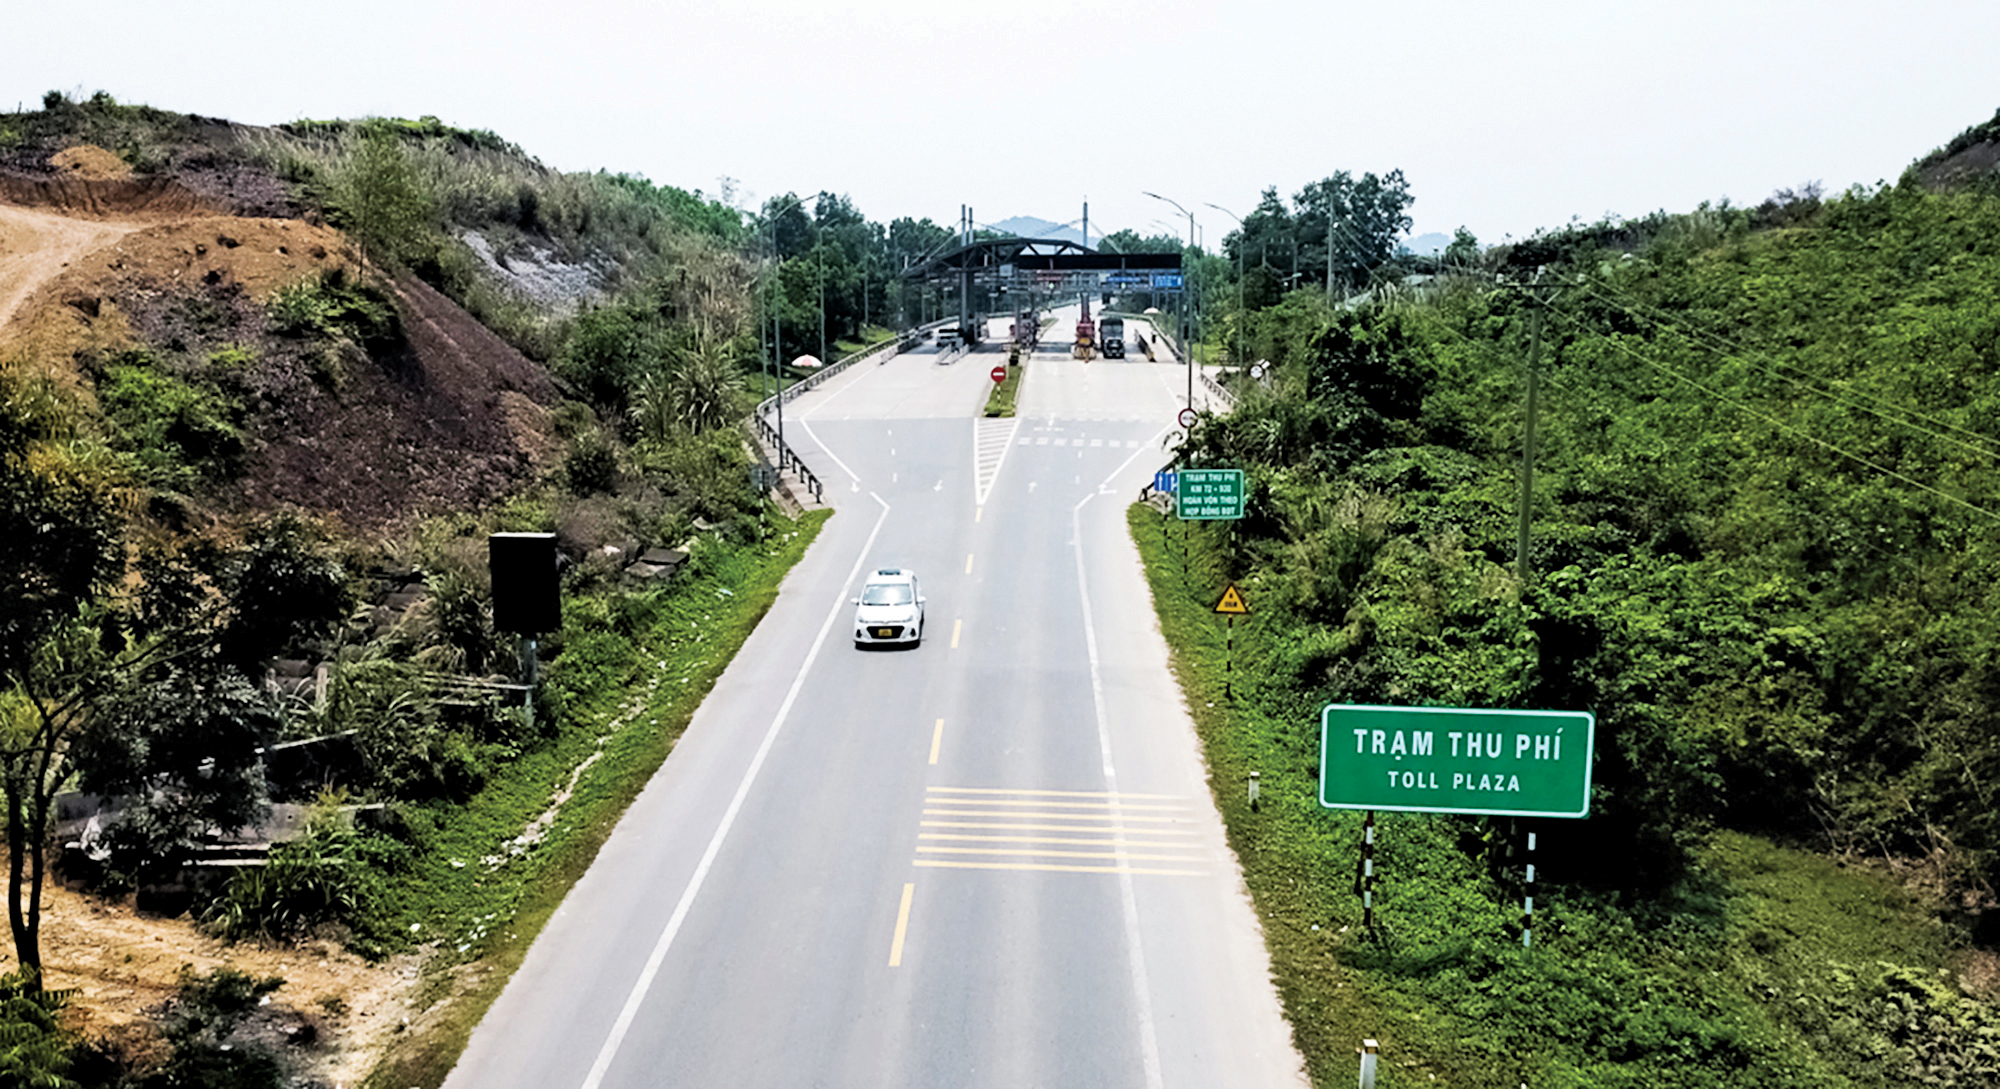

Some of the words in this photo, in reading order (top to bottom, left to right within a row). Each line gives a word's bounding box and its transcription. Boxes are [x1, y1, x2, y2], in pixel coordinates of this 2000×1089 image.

[1208, 473, 1223, 482] THU
[1353, 728, 1433, 761] TRẠM
[1448, 731, 1503, 758] THU
[1516, 727, 1564, 761] PHÍ
[1387, 770, 1439, 789] TOLL
[1453, 773, 1520, 792] PLAZA
